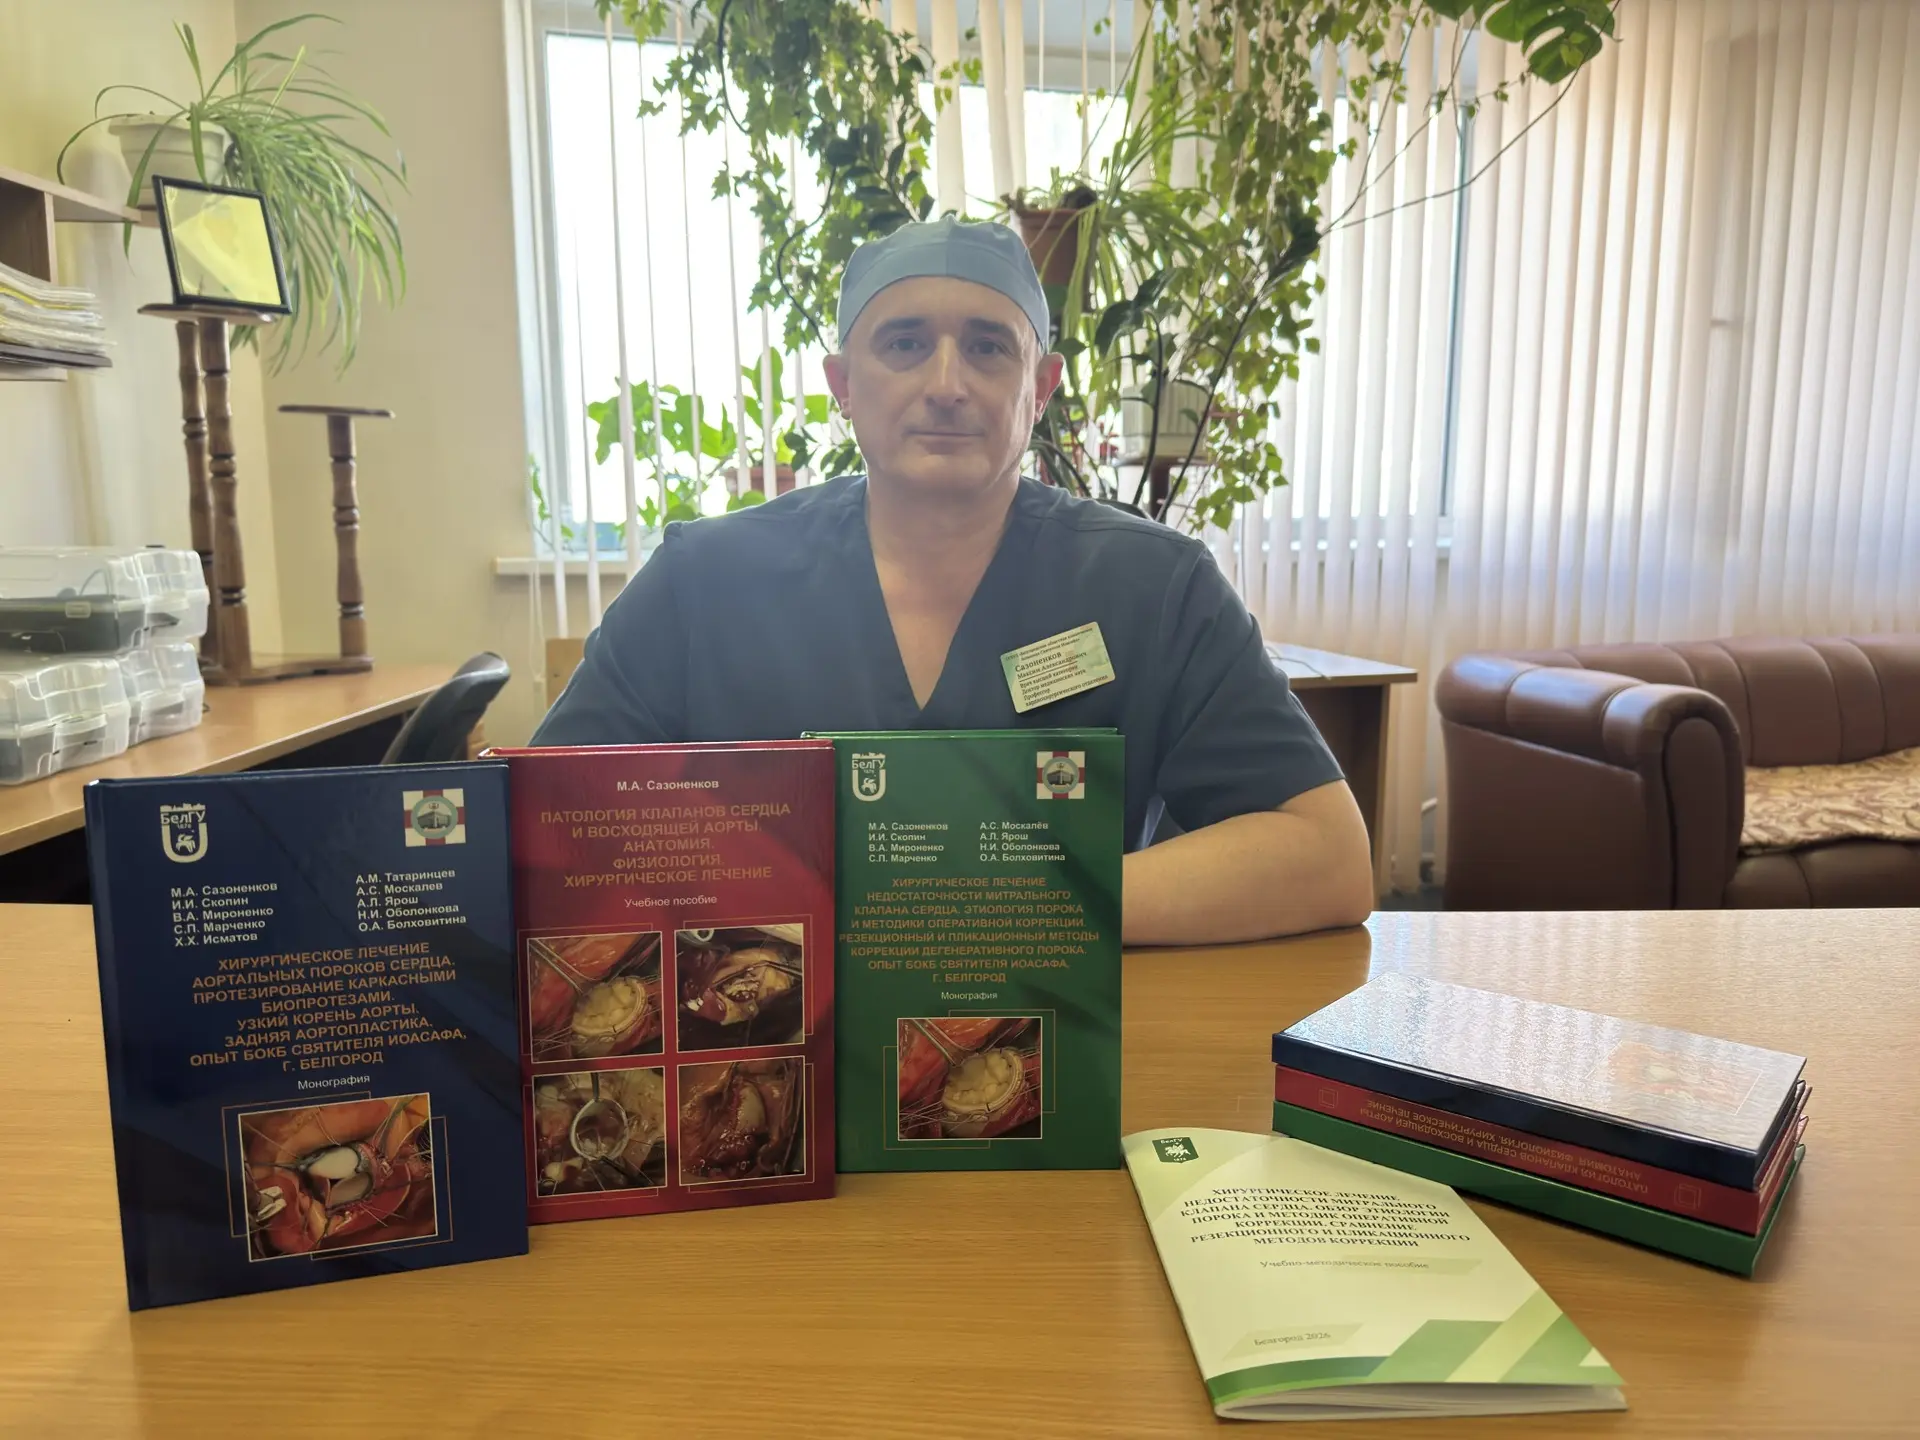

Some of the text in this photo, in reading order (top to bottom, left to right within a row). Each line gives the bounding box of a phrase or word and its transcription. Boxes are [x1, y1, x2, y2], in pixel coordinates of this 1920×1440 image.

[1015, 652, 1062, 672] Сазоненков
[852, 759, 886, 770] БелГУ
[617, 780, 719, 792] М.А. Сазоненков
[160, 811, 205, 824] БелГУ
[541, 803, 791, 823] ПАТОЛОГИЯ КЛАПАНОВ СЕРДЦА
[572, 827, 582, 838] И
[588, 819, 699, 838] ВОСХОДЯЩЕЙ
[868, 822, 948, 831] М.А. Сазоненков
[980, 821, 1048, 830] А.С. Москалёв
[868, 833, 926, 842] И.И. Скопин
[980, 832, 1028, 842] А.Л. Ярош
[868, 844, 944, 853] В.А. Мироненко
[980, 842, 1060, 852] Н.И. Оболонкова
[868, 854, 938, 864] С.П. Марченко
[980, 853, 1066, 862] О.А. Болховитина
[356, 870, 456, 884] А.М. Татаринцев
[564, 866, 772, 888] ХИРУРГИЧЕСКОЕ ЛЕЧЕНИЕ
[892, 877, 1046, 888] ХИРУРГИЧЕСКОЕ ЛЕЧЕНИЕ
[171, 882, 278, 898] М.А. Сазоненков
[356, 882, 443, 896] А.С. Москалев
[358, 896, 418, 908] А.Л. Ярош
[624, 895, 718, 908] Учебное пособие
[867, 890, 1070, 902] НЕДОСТАТОЧНОСТИ МИТРАЛЬНОГО
[172, 897, 248, 910] И.И. Скопин
[854, 904, 1084, 916] КЛАПАНА СЕРДЦА. ЭТИОЛОГИЯ ПОРОКА
[173, 908, 274, 922] В.А. Мироненко
[358, 904, 459, 920] Н.И. Оболонкова
[174, 920, 266, 934] С.П. Марченко
[358, 915, 466, 932] О.А. Болховитина
[852, 918, 1086, 929] И МЕТОДИКИ ОПЕРАТИВНОЙ КОРРЕКЦИИ.
[175, 933, 258, 947] Х.Х. Исматов
[839, 930, 1099, 943] РЕЗЕКЦИОННЫЙ И ПЛИКАЦИОННЫЙ МЕТОДЫ
[218, 942, 430, 970] ХИРУРГИЧЕСКОЕ ЛЕЧЕНИЕ
[850, 946, 918, 956] КОРРЕКЦИИ
[922, 946, 1034, 956] ДЕГЕНЕРАТИВНОГО
[868, 960, 902, 970] ОПЫТ
[905, 960, 936, 969] БОКБ
[940, 960, 1007, 969] СВЯТИТЕЛЯ
[192, 956, 456, 988] АОРТАЛЬНЫХ ПОРОКОВ СЕРДЦА.
[932, 973, 1006, 983] Г. БЕЛГОРОД
[194, 970, 456, 1004] ПРОТЕЗИРОВАНИЕ КАРКАСНЫМИ
[262, 991, 395, 1014] БИОПРОТЕЗАМИ.
[941, 992, 998, 1001] Монография
[237, 1003, 420, 1032] УЗКИЙ КОРЕНЬ АОРТЫ.
[224, 1016, 433, 1048] ЗАДНЯЯ АОРТОПЛАСТИКА.
[190, 1028, 466, 1066] ОПЫТ БОКБ СВЯТИТЕЛЯ ИОАСАФА,
[282, 1052, 384, 1072] Г. БЕЛГОРОД
[298, 1075, 370, 1090] Монография
[1367, 1100, 1410, 1118] ЛЕЧЕНИЕ
[1413, 1112, 1496, 1142] ХИРУРГИЧЕСКОЕ
[1360, 1108, 1648, 1194] ПАТОЛОГИЯ КЛАПАНОВ СЕРДЦА И ВОСХОДЯЩЕЙ АОРТЫ
[1212, 1188, 1400, 1200] ХИРУРГИЧЕСКОЕ ЛЕЧЕНИЕ
[1184, 1196, 1436, 1210] НЕДОСТАТОЧНОСТИ МИТРАЛЬНОГО
[1180, 1204, 1250, 1217] КЛАПАНА
[1316, 1204, 1358, 1212] ОБЗОР
[1362, 1207, 1450, 1218] ЭТИОЛОГИИ
[1192, 1212, 1251, 1224] ПОРОКА
[1342, 1213, 1449, 1225] ОПЕРАТИВНОЙ
[1235, 1220, 1417, 1231] КОРРЕКЦИИ. СРАВНЕНИЕ
[1191, 1228, 1318, 1243] РЕЗЕКЦИОННОГО
[1337, 1230, 1470, 1242] ПЛИКАЦИОННОГО
[1254, 1236, 1419, 1247] МЕТОДОВ КОРРЕКЦИИ
[1260, 1260, 1382, 1268] Учебно-методическое
